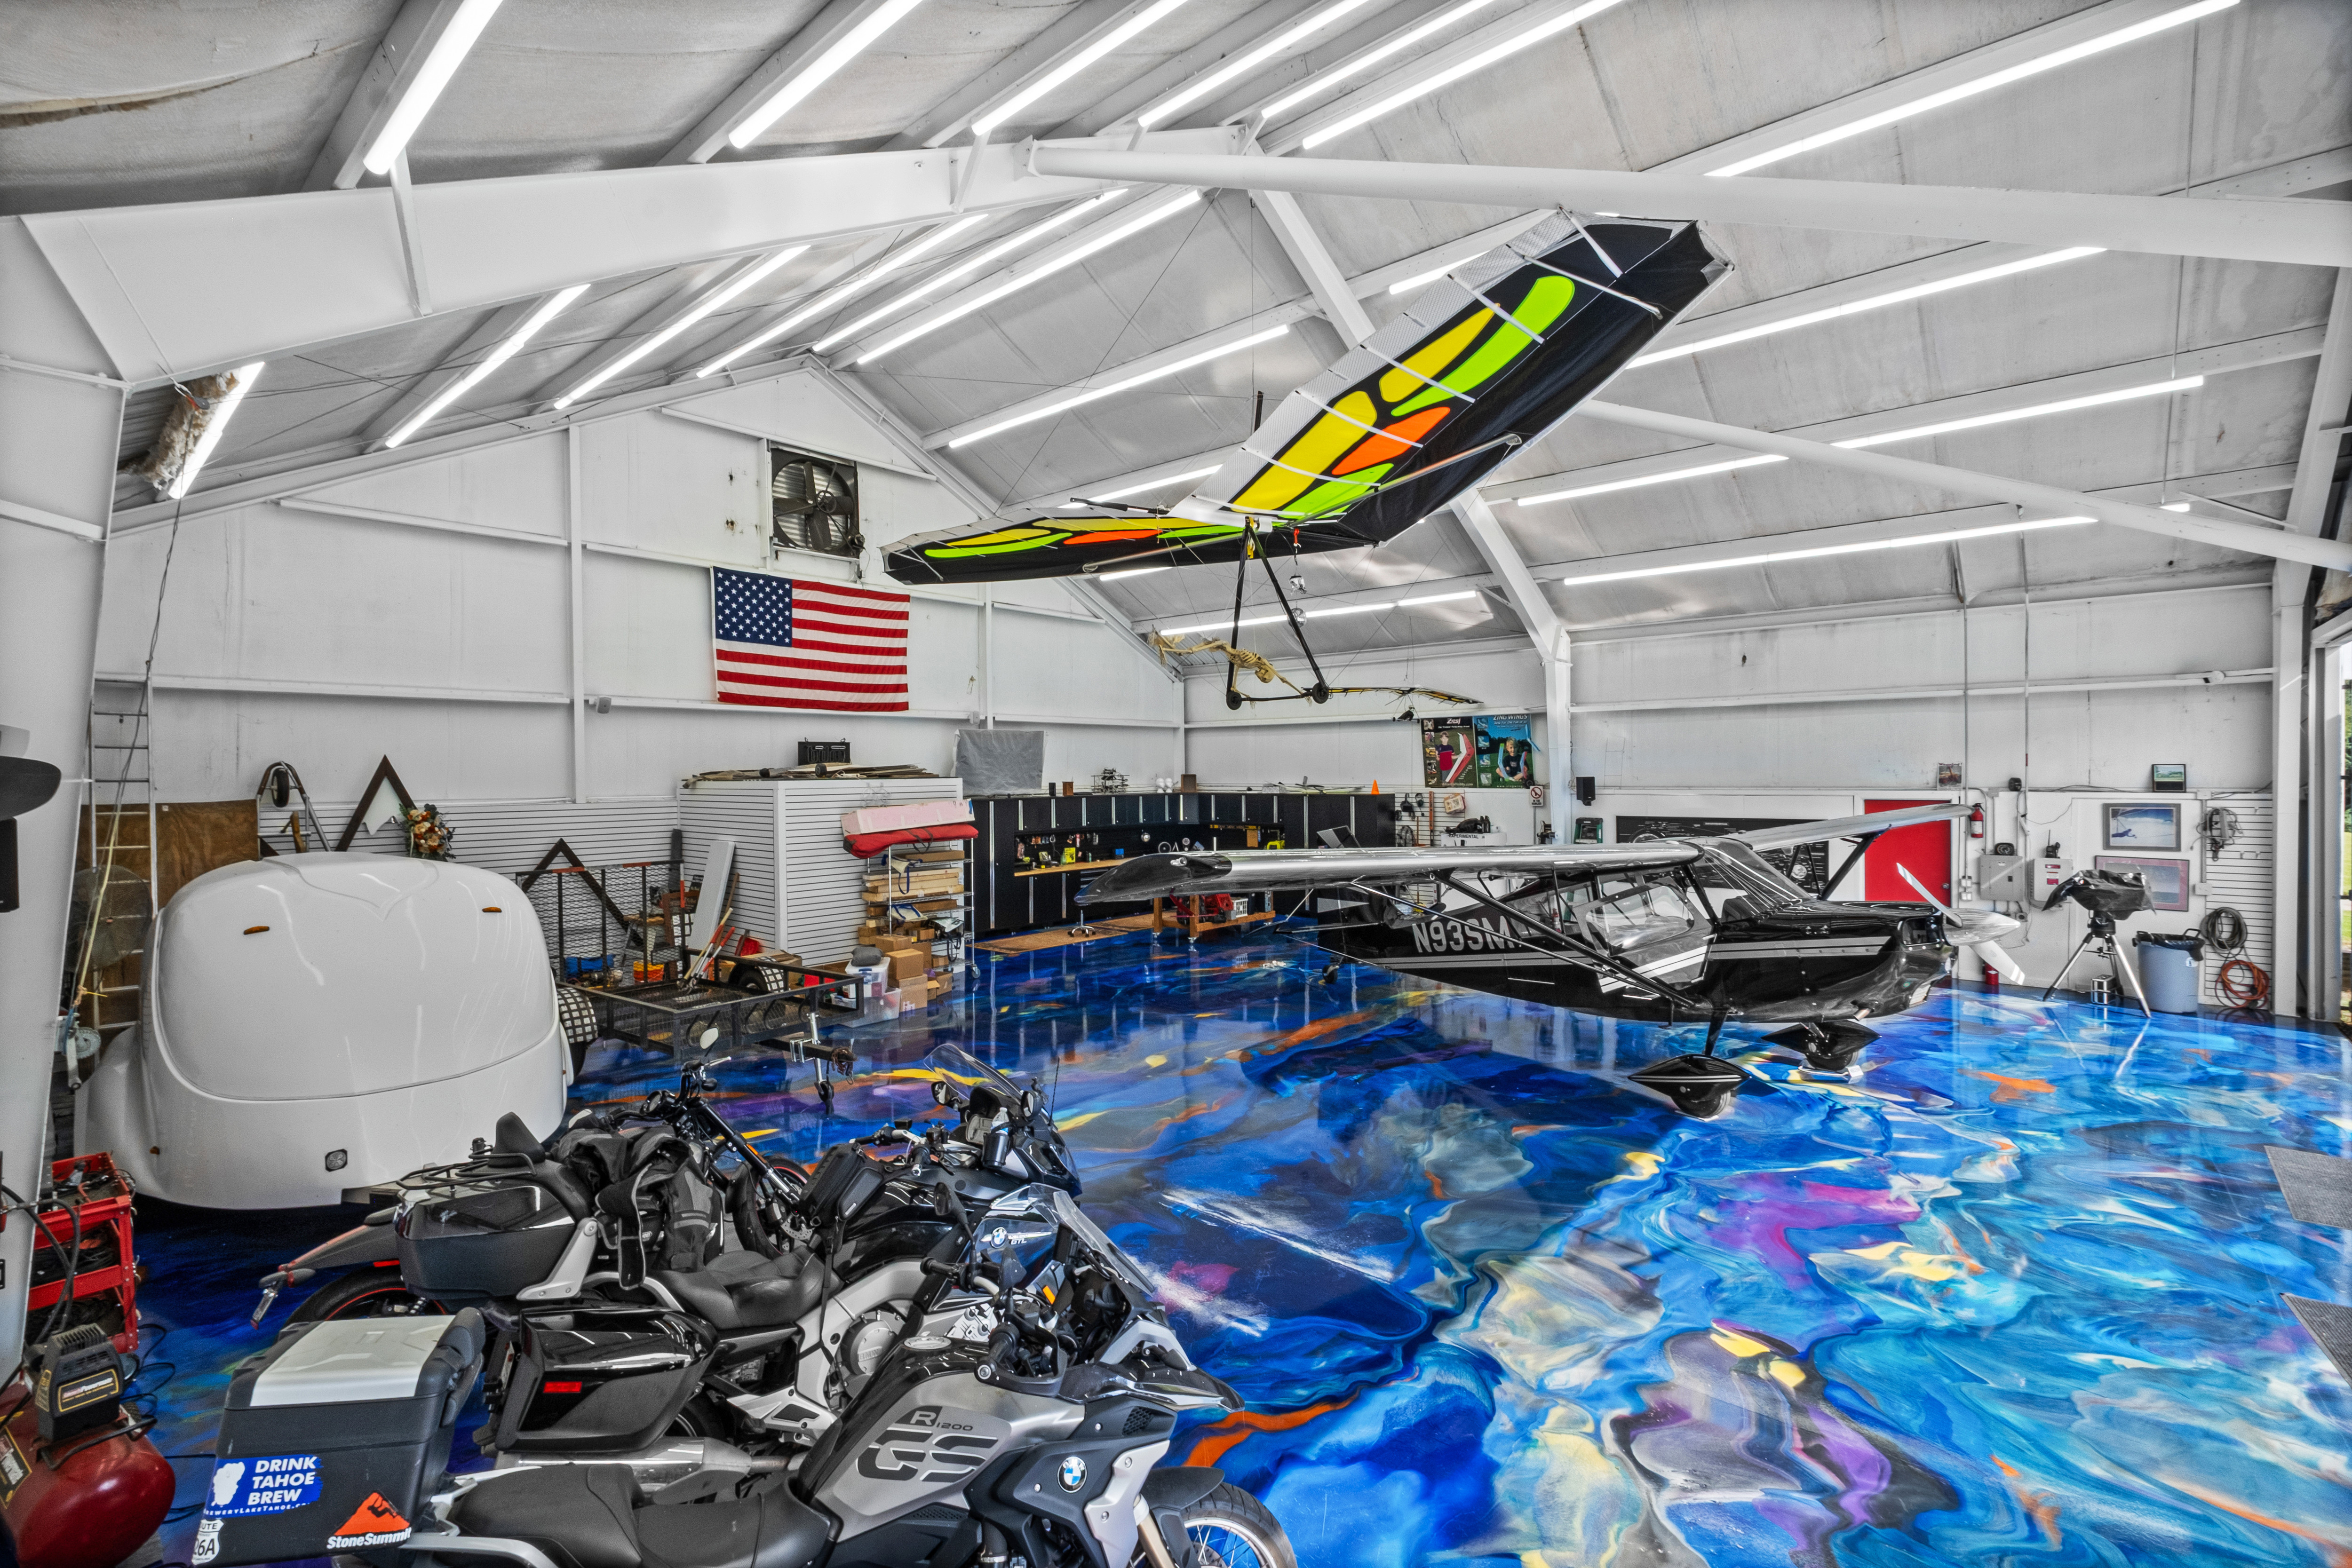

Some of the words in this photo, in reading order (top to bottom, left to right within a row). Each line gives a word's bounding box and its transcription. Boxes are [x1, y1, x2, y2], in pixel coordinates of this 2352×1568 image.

[1412, 915, 1515, 953] N93SM
[909, 1410, 937, 1425] R
[937, 1421, 973, 1431] 1200
[255, 1456, 318, 1473] DRINK
[855, 1427, 999, 1483] GS
[252, 1472, 316, 1489] TAHOE
[247, 1489, 302, 1505] BREW
[326, 1527, 412, 1549] StoneSummit
